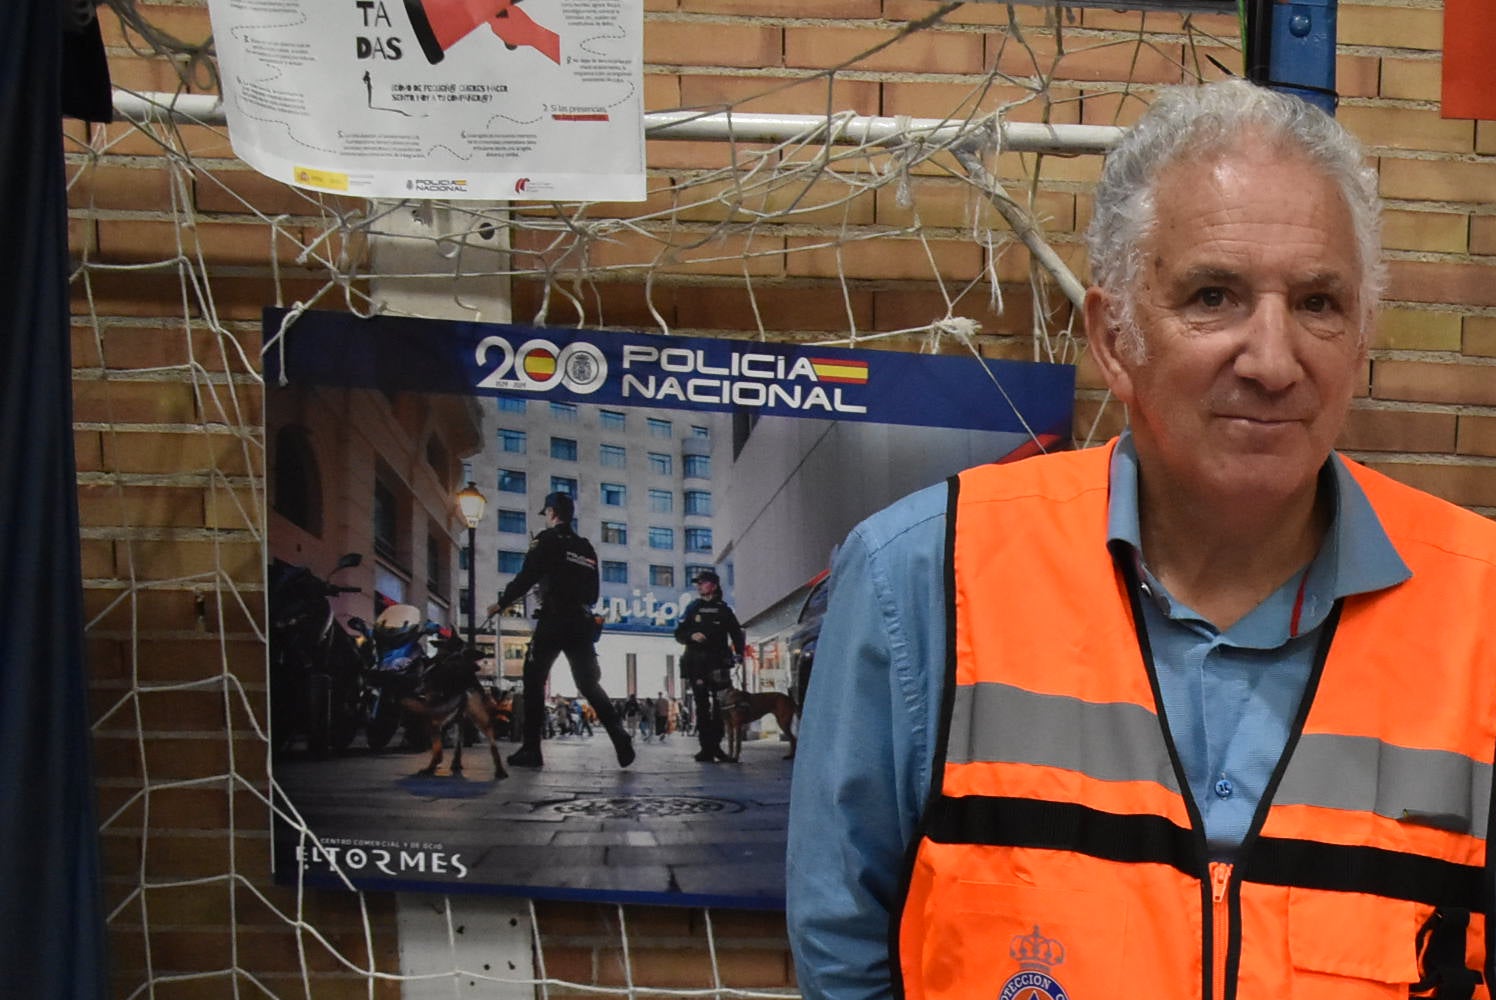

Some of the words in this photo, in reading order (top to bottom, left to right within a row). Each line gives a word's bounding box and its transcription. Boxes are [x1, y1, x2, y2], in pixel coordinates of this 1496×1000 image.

[356, 36, 403, 60] DAS
[622, 374, 868, 414] NACIONAL
[324, 847, 468, 879] TORMES
